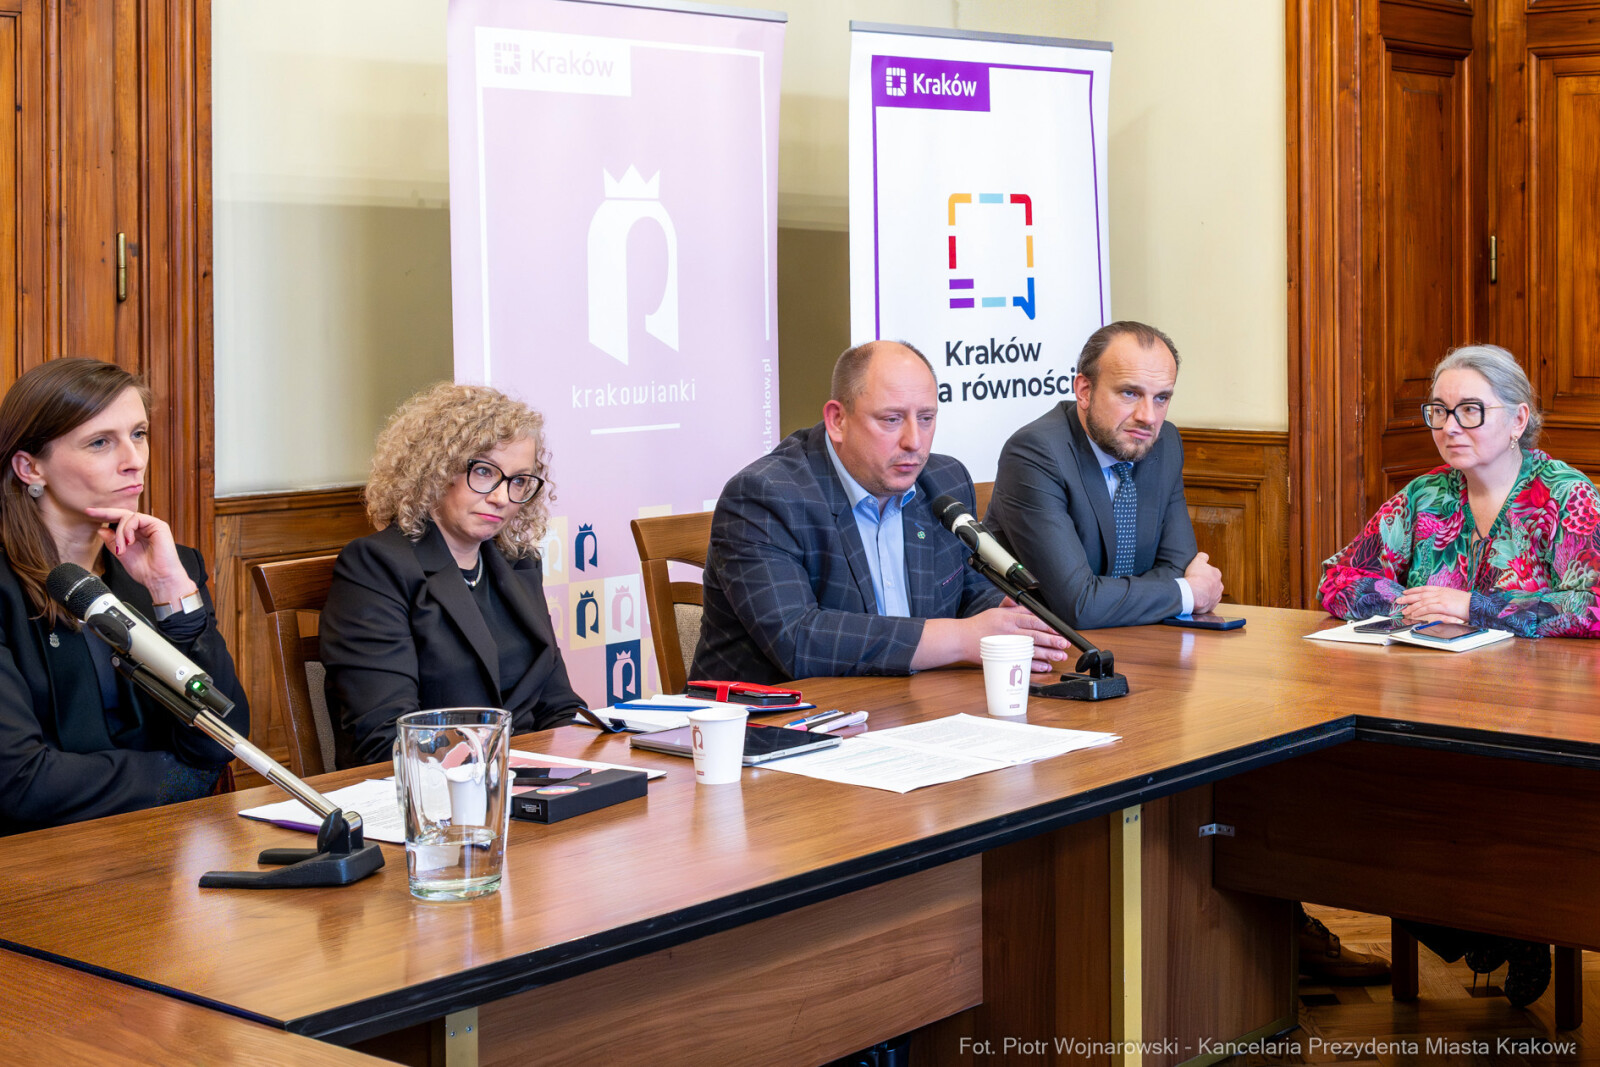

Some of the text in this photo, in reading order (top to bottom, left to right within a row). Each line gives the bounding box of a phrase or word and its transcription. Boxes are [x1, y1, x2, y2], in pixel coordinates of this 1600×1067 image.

[531, 49, 614, 78] Kraków
[912, 72, 977, 97] Kraków
[945, 336, 1042, 367] Kraków
[572, 378, 696, 409] krakowianki
[962, 367, 1076, 401] równości
[762, 358, 772, 455] ki.krakow.pl
